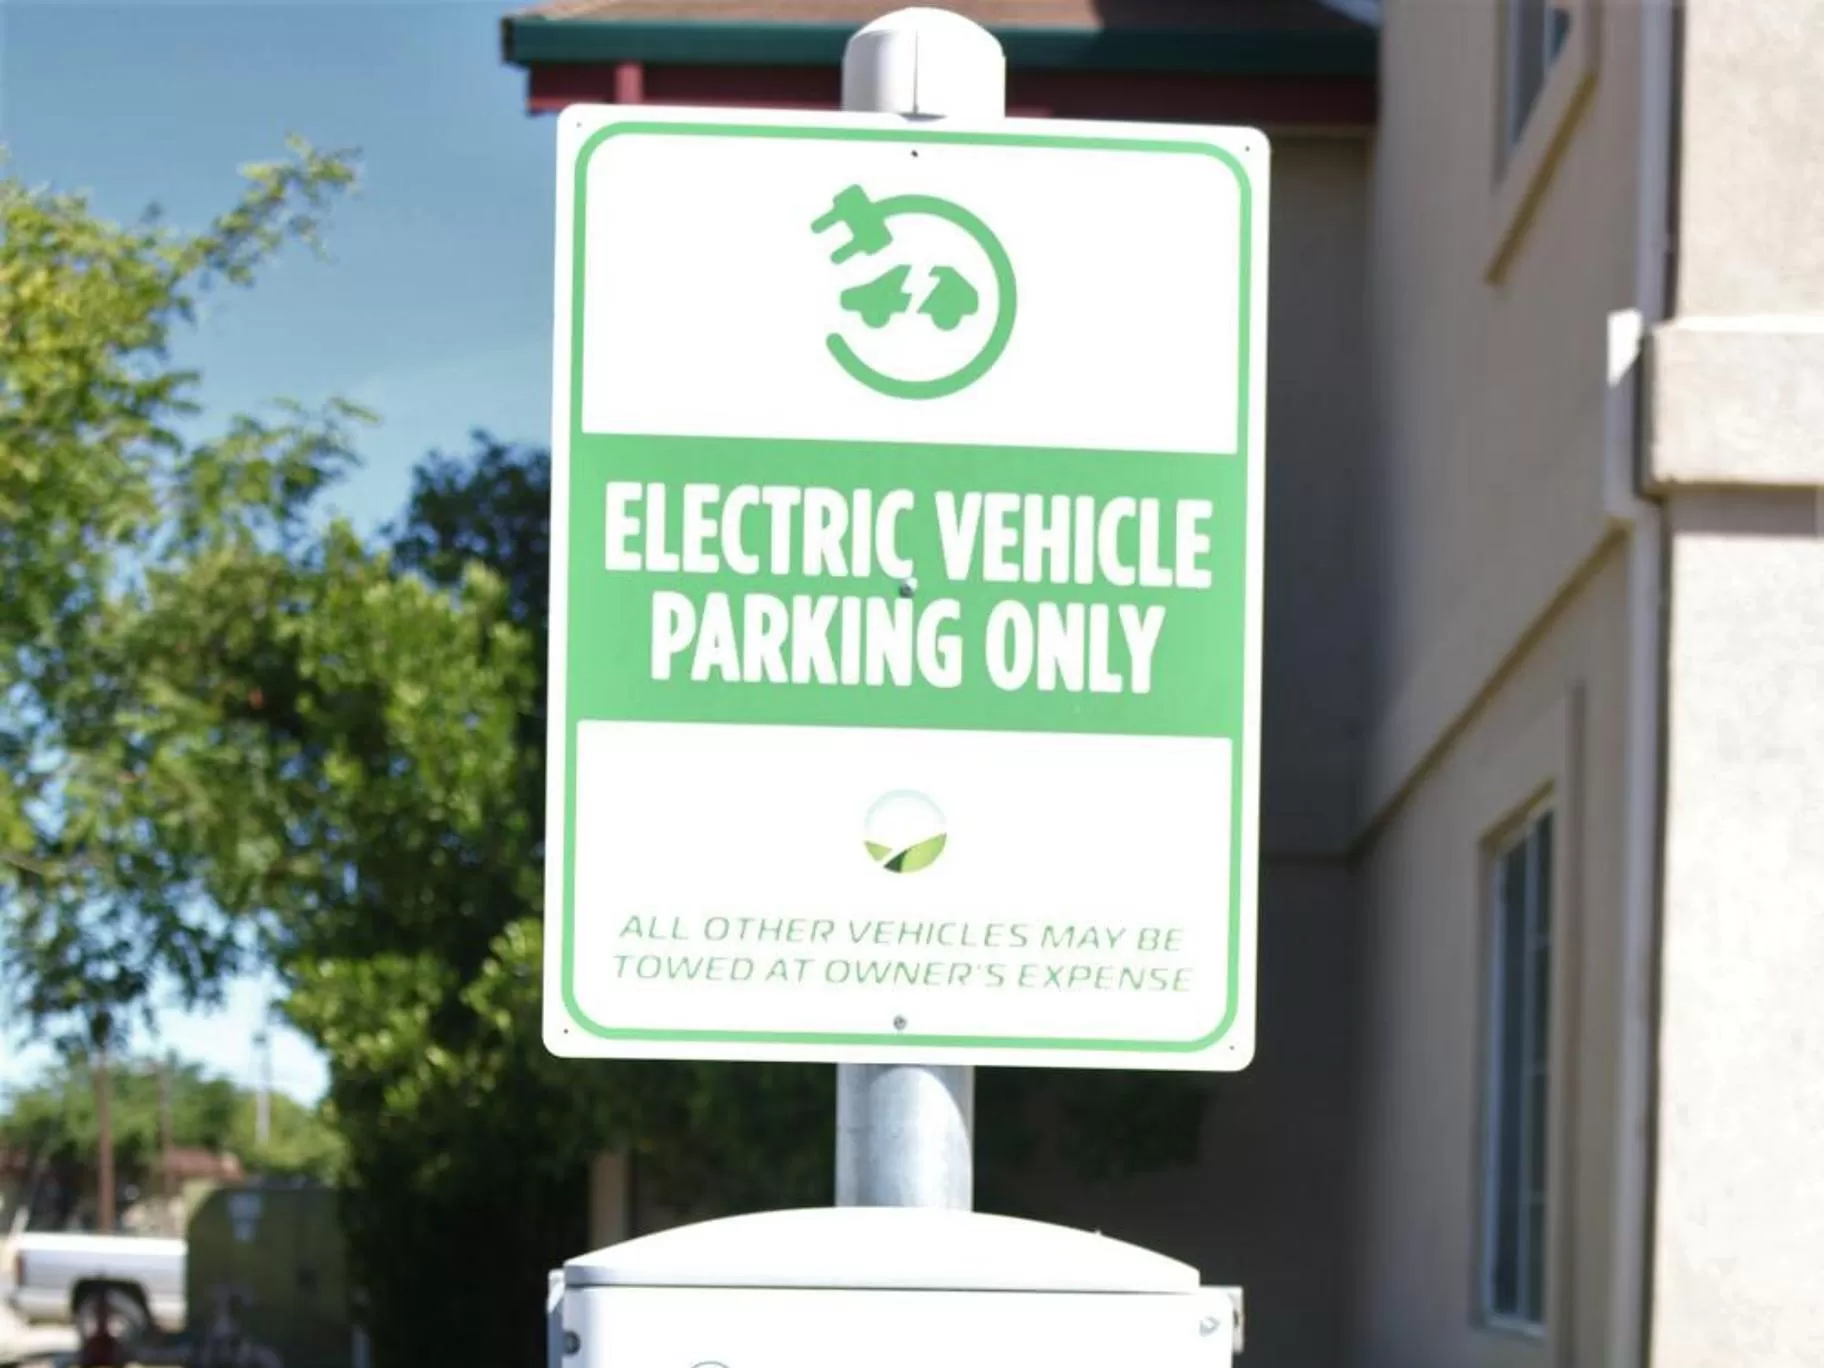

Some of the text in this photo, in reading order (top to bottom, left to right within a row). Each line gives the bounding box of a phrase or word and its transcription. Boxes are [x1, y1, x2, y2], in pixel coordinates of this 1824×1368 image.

[605, 481, 1212, 588] ELECTRIC VEHICLE
[651, 591, 1165, 693] PARKING ONLY
[618, 914, 1185, 953] ALL OTHER VEHICLES MAY BE
[612, 954, 1194, 993] TOWED AT OWNER'S EXPENSE
